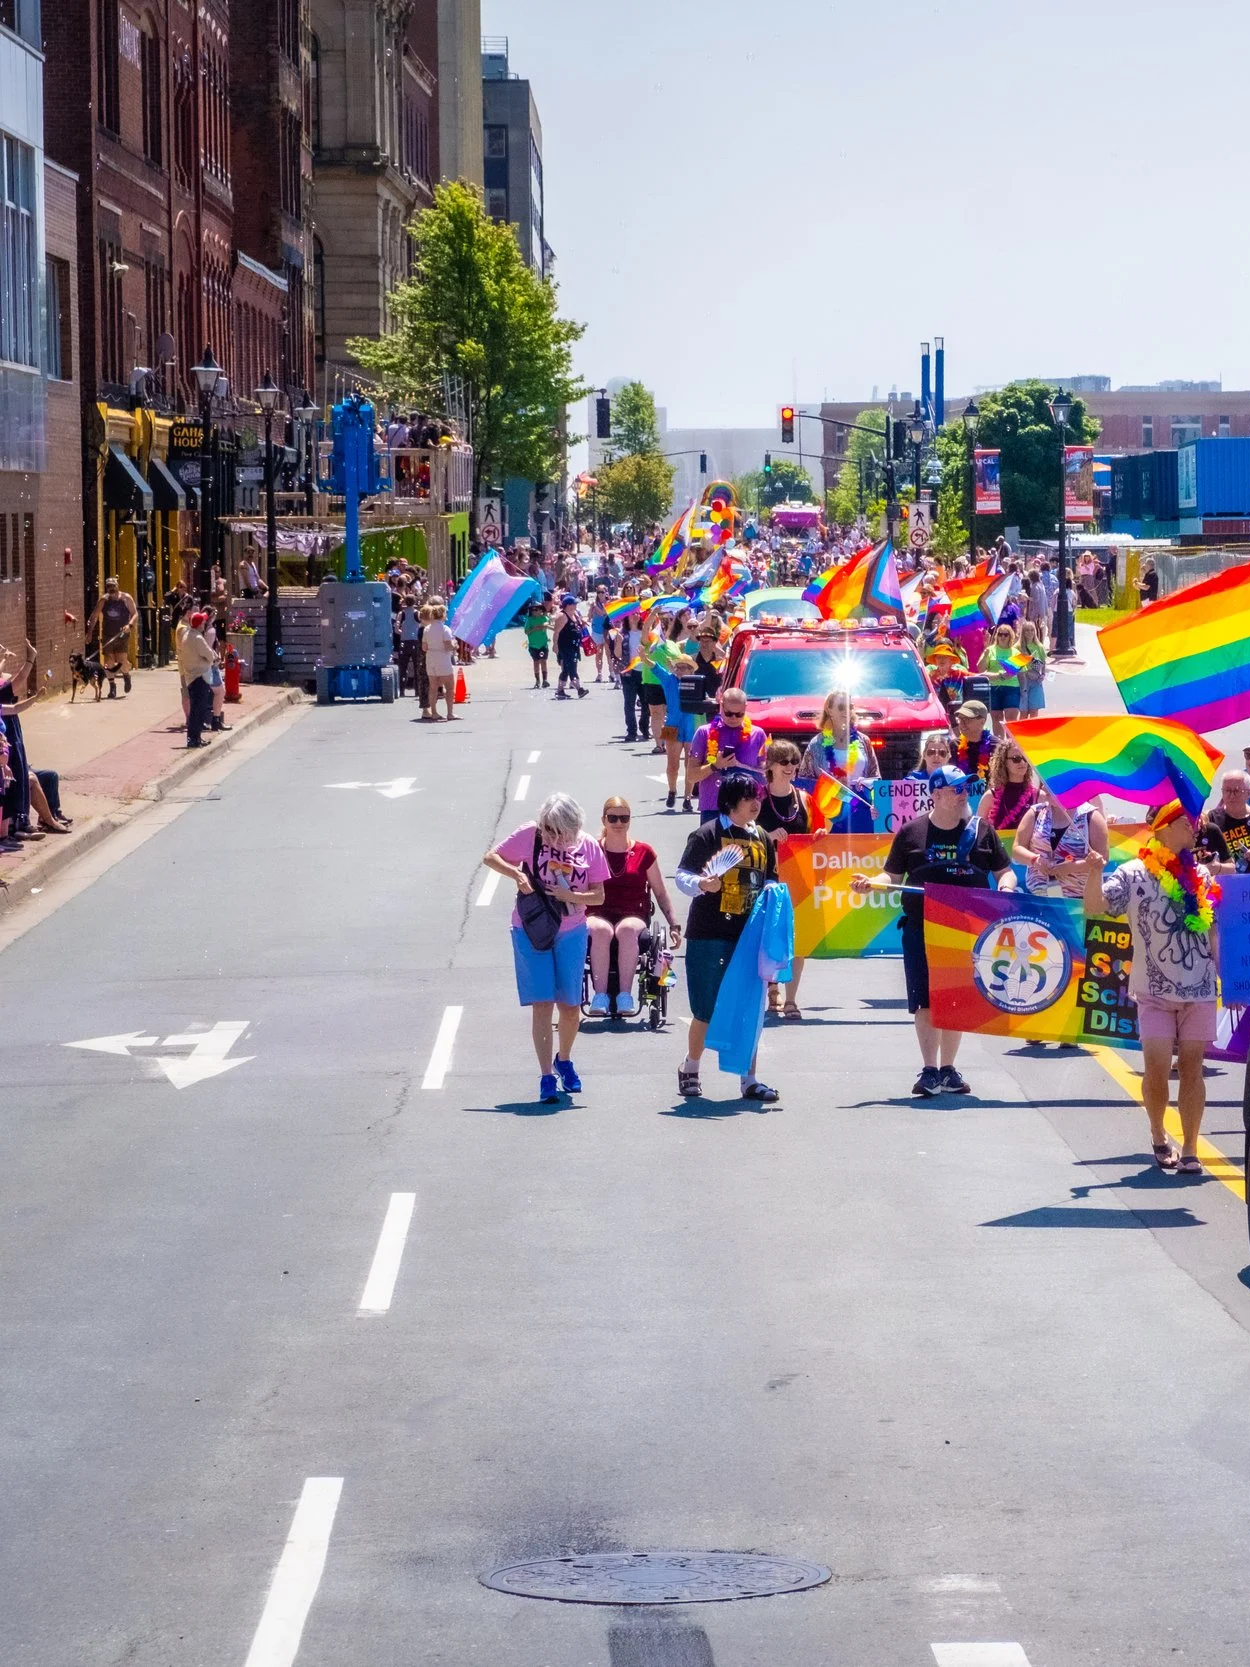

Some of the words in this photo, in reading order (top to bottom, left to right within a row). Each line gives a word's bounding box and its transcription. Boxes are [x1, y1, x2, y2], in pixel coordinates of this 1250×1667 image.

[173, 426, 204, 438] GAHA
[173, 437, 204, 448] HOUS
[878, 783, 928, 798] GENDER
[912, 798, 935, 813] CAR
[1223, 825, 1248, 843] EACE
[812, 852, 887, 870] Dalhou
[1035, 917, 1051, 928] South
[1087, 925, 1131, 949] Ang
[1081, 981, 1135, 1008] Sch
[998, 1001, 1017, 1012] School
[1017, 1004, 1039, 1012] District
